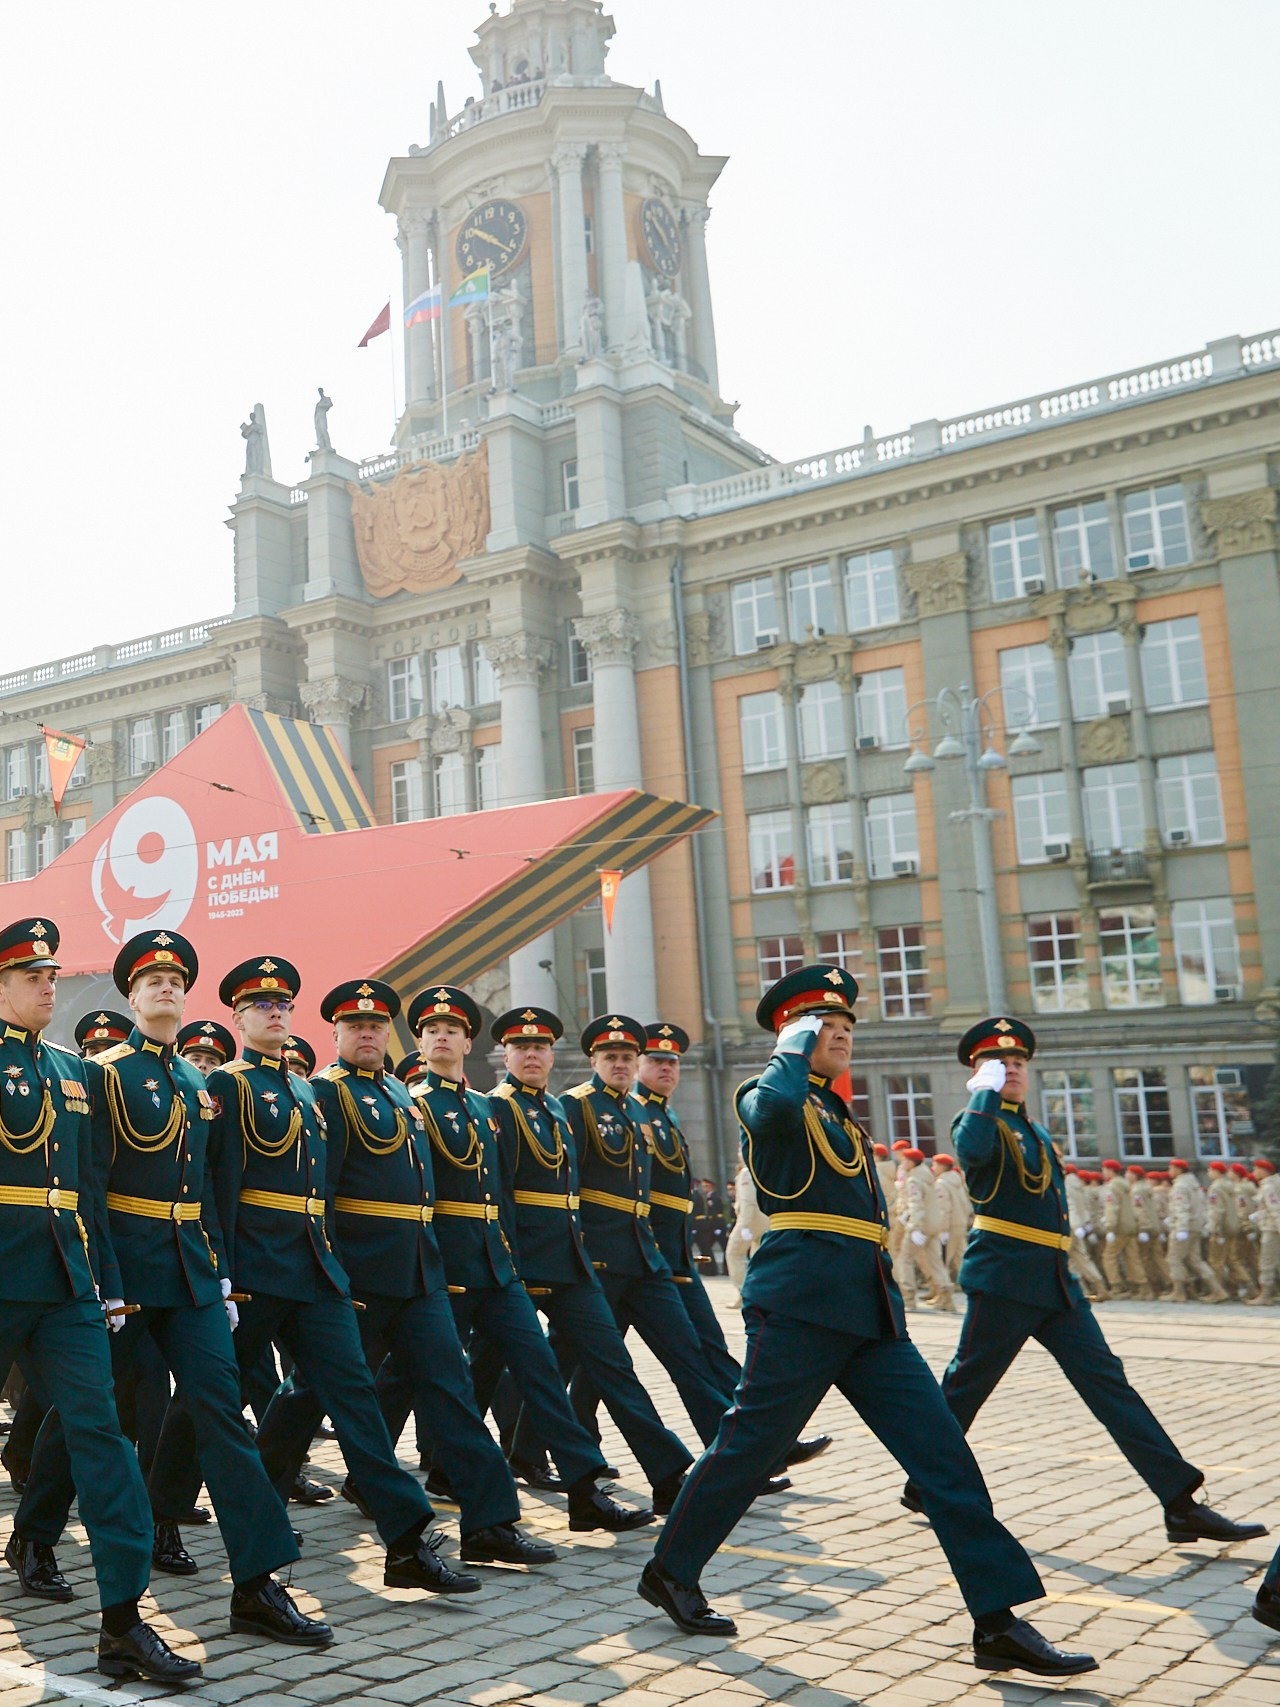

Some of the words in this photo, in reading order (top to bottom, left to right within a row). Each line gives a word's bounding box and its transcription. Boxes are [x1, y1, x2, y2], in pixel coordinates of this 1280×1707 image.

[485, 207, 495, 220] 12
[474, 215, 482, 227] 11
[465, 228, 474, 240] 10
[513, 223, 520, 235] 3
[462, 243, 470, 254] 9
[466, 255, 473, 267] 8
[109, 796, 199, 944] 9
[206, 832, 278, 869] МАЯ
[208, 876, 218, 890] С
[221, 867, 265, 890] ДНЁМ
[208, 885, 279, 907] ПОБЕДЫ!
